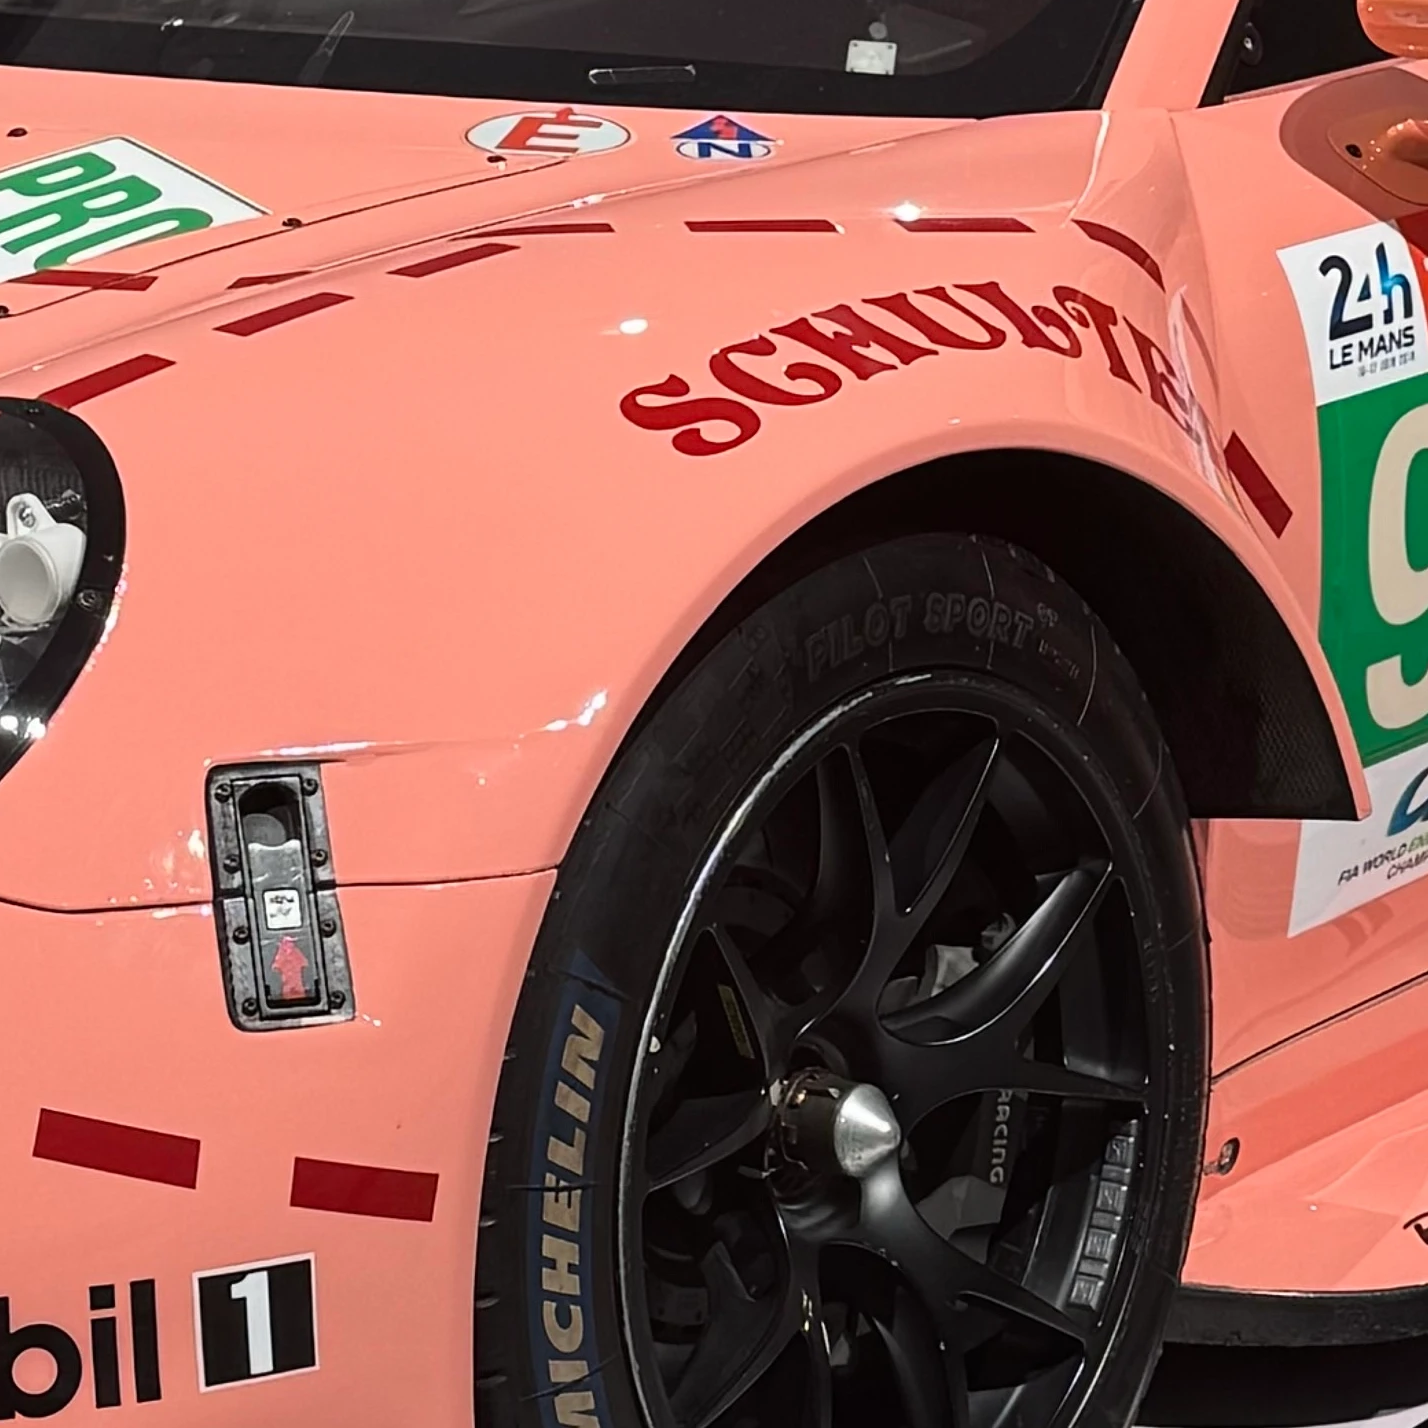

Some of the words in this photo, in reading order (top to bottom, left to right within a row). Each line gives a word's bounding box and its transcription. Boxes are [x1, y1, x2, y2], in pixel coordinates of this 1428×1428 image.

[1318, 241, 1414, 341] 24h
[1329, 342, 1354, 370] LE
[1358, 324, 1415, 362] MANS
[804, 594, 912, 683] PILOT
[923, 591, 1035, 651] SPORT
[1361, 842, 1408, 875] WORLD
[228, 1269, 276, 1378] 1
